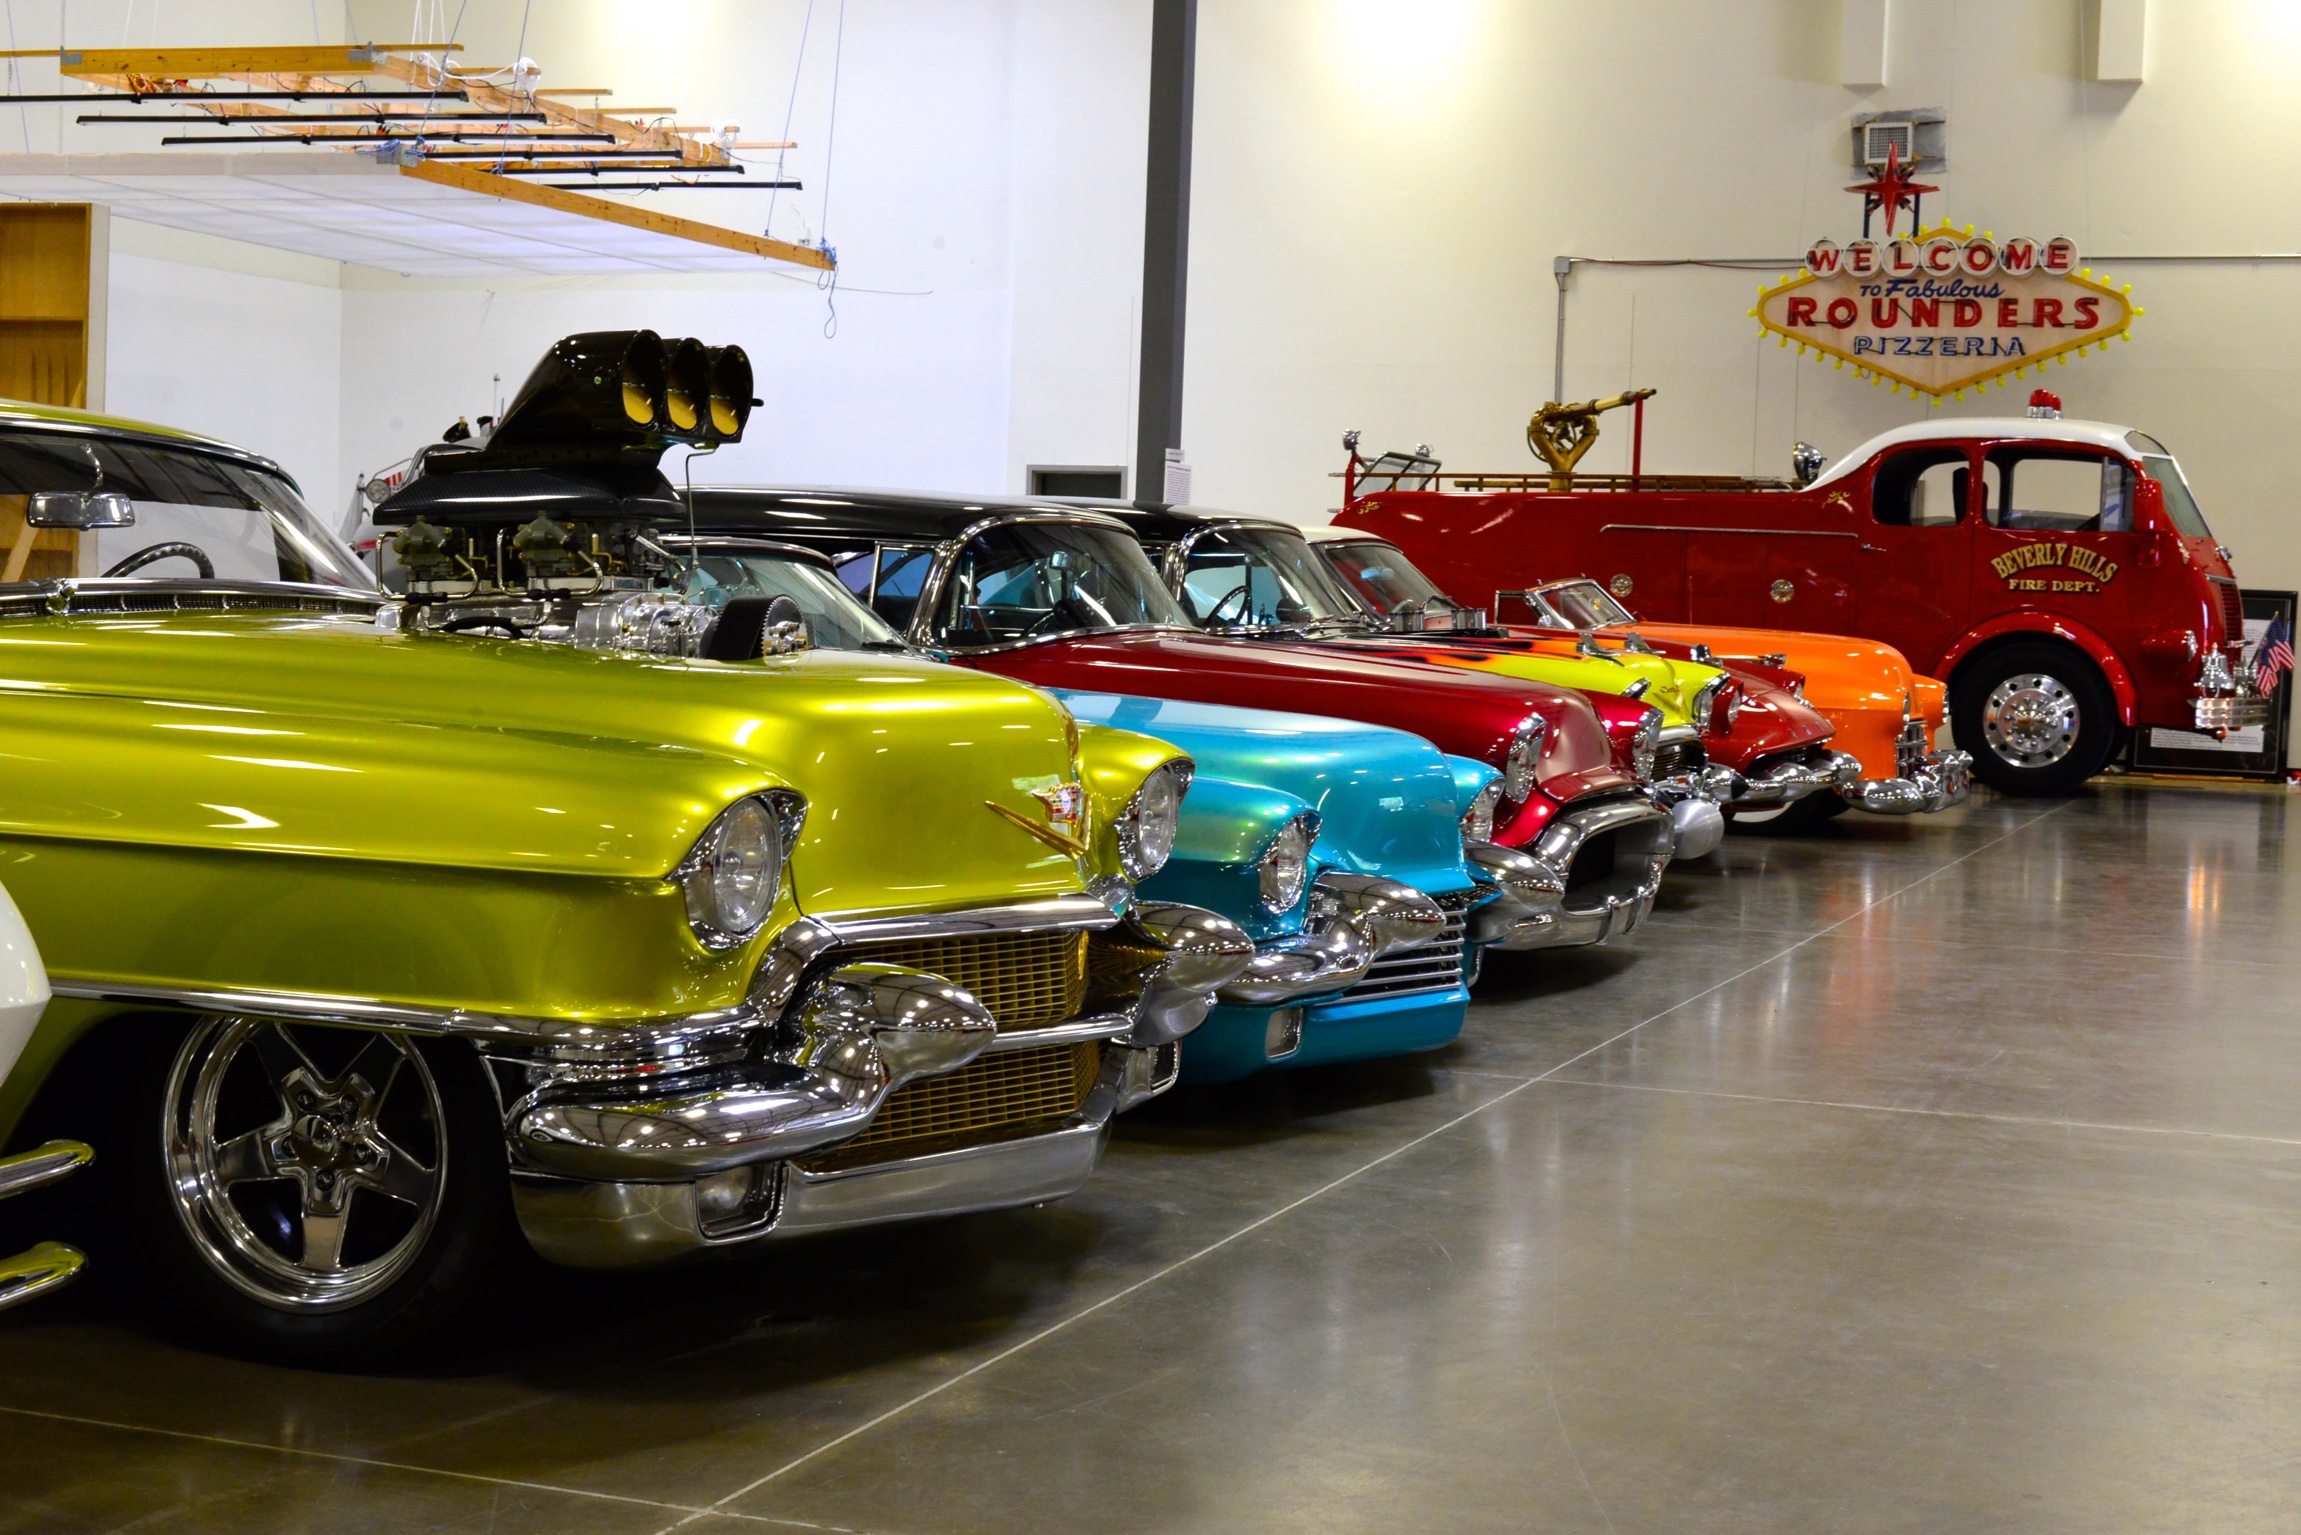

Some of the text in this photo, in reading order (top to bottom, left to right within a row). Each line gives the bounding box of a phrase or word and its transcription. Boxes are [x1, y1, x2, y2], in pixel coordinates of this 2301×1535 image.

[1808, 244, 2070, 272] WELCOME
[1884, 279, 2006, 299] Fabulous
[1787, 297, 2100, 329] ROUNDERS
[1854, 336, 2027, 356] PIZZERIA
[1990, 542, 2119, 583] BEVERLY HILLS
[2009, 579, 2101, 593] FIRE DEPT.
